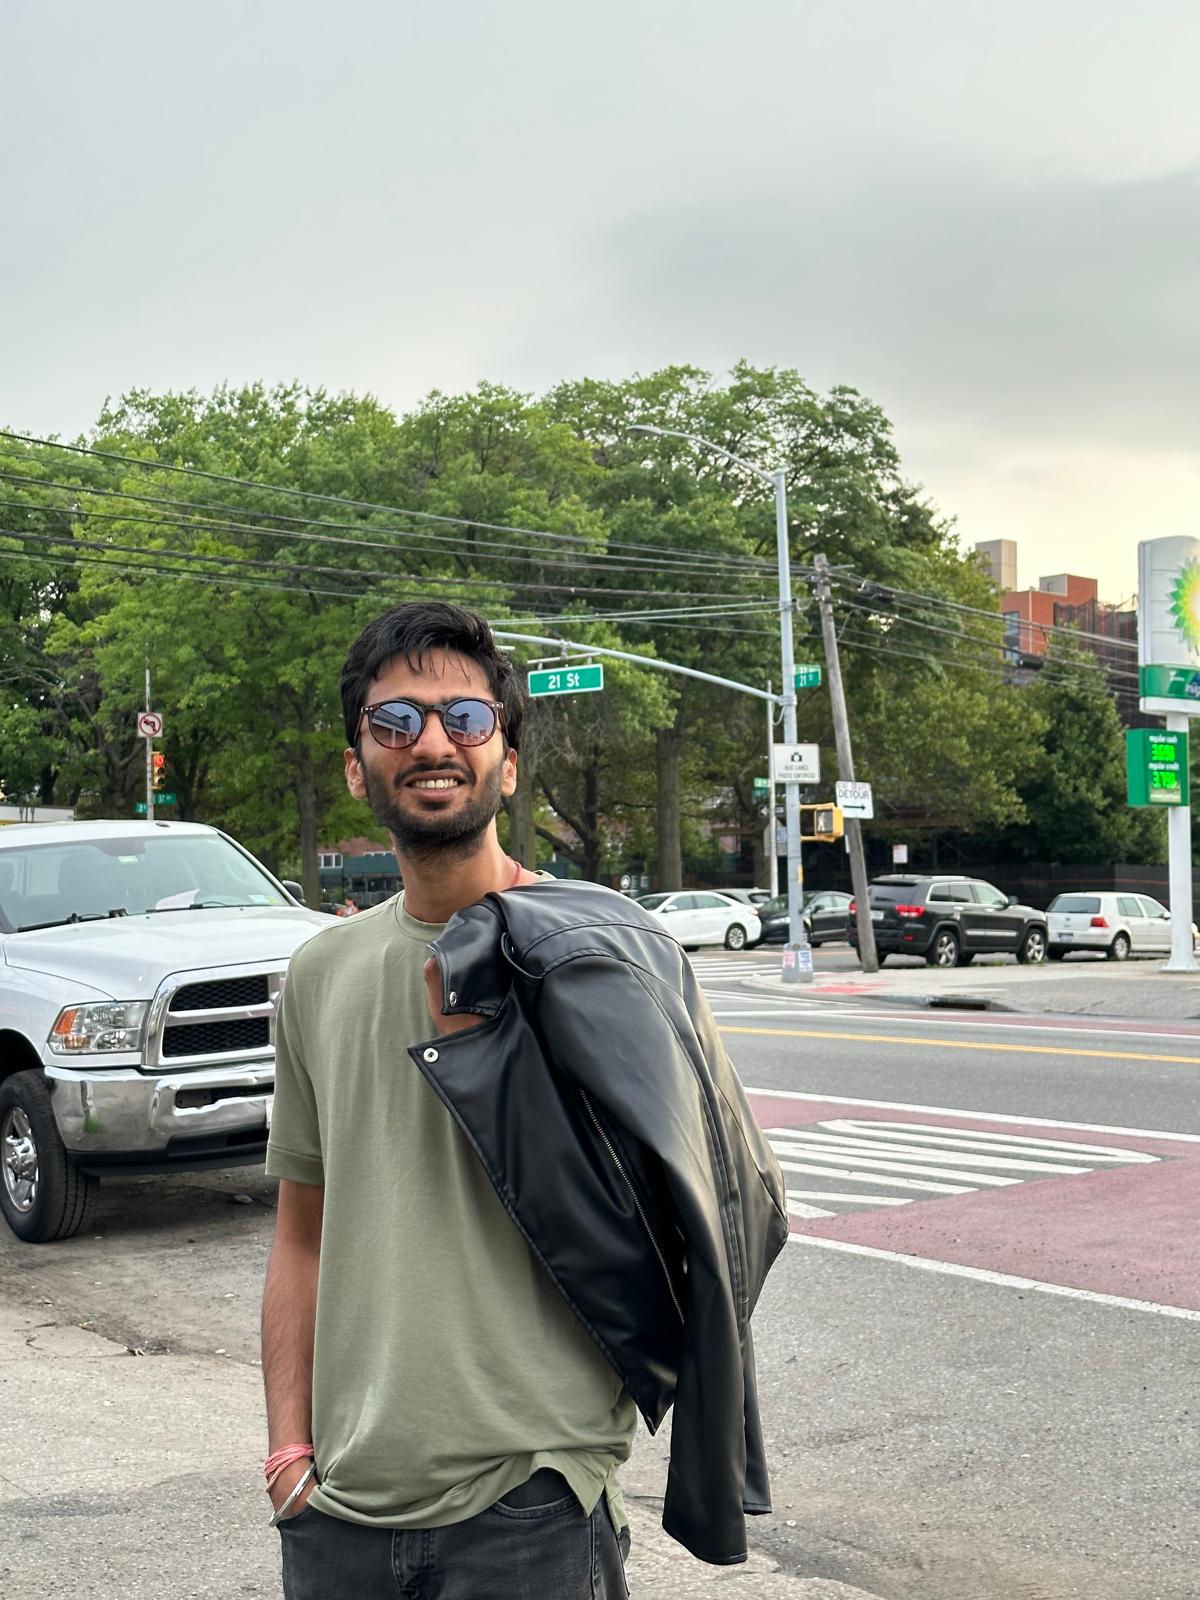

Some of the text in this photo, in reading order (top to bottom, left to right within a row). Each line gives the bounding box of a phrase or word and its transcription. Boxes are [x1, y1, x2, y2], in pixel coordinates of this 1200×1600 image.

[548, 673, 580, 689] 21 St
[839, 790, 869, 800] DETOUR
